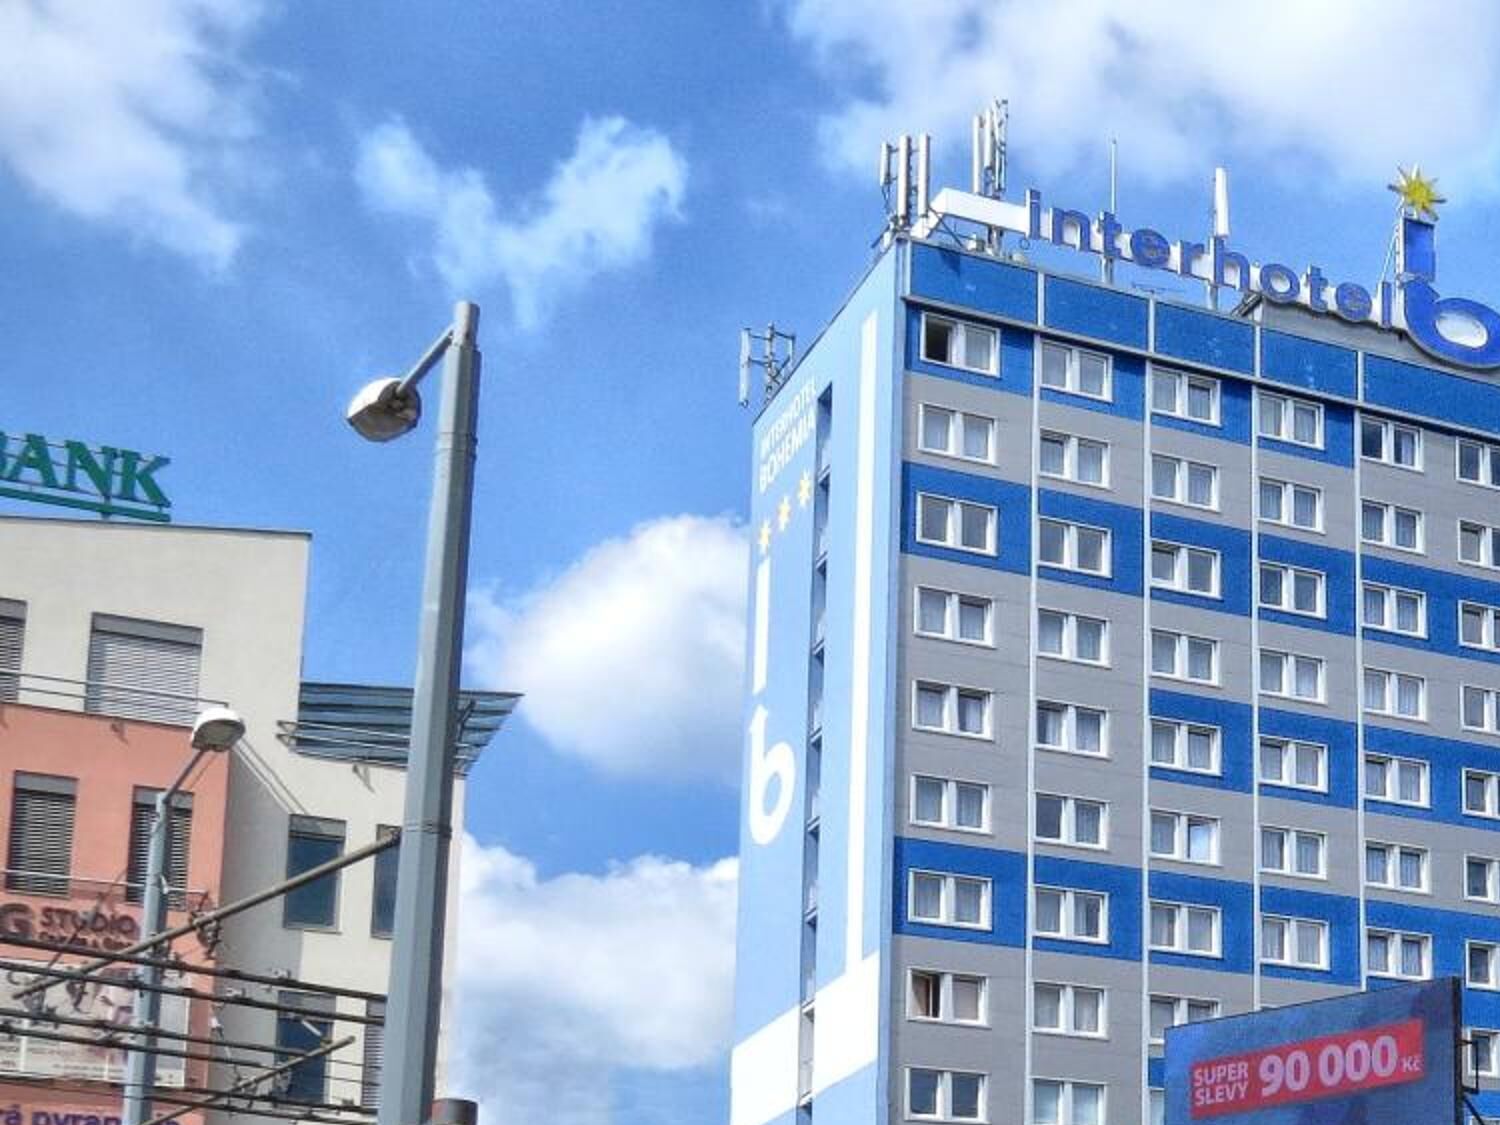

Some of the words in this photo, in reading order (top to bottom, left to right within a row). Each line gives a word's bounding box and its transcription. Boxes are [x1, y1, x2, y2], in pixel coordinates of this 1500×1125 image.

[1026, 190, 1392, 328] interhotel
[1193, 1061, 1249, 1088] SUPER
[1258, 1051, 1311, 1097] 90
[1317, 1035, 1399, 1087] 000
[1401, 1054, 1423, 1073] Kč
[1193, 1081, 1249, 1107] SLEVY
